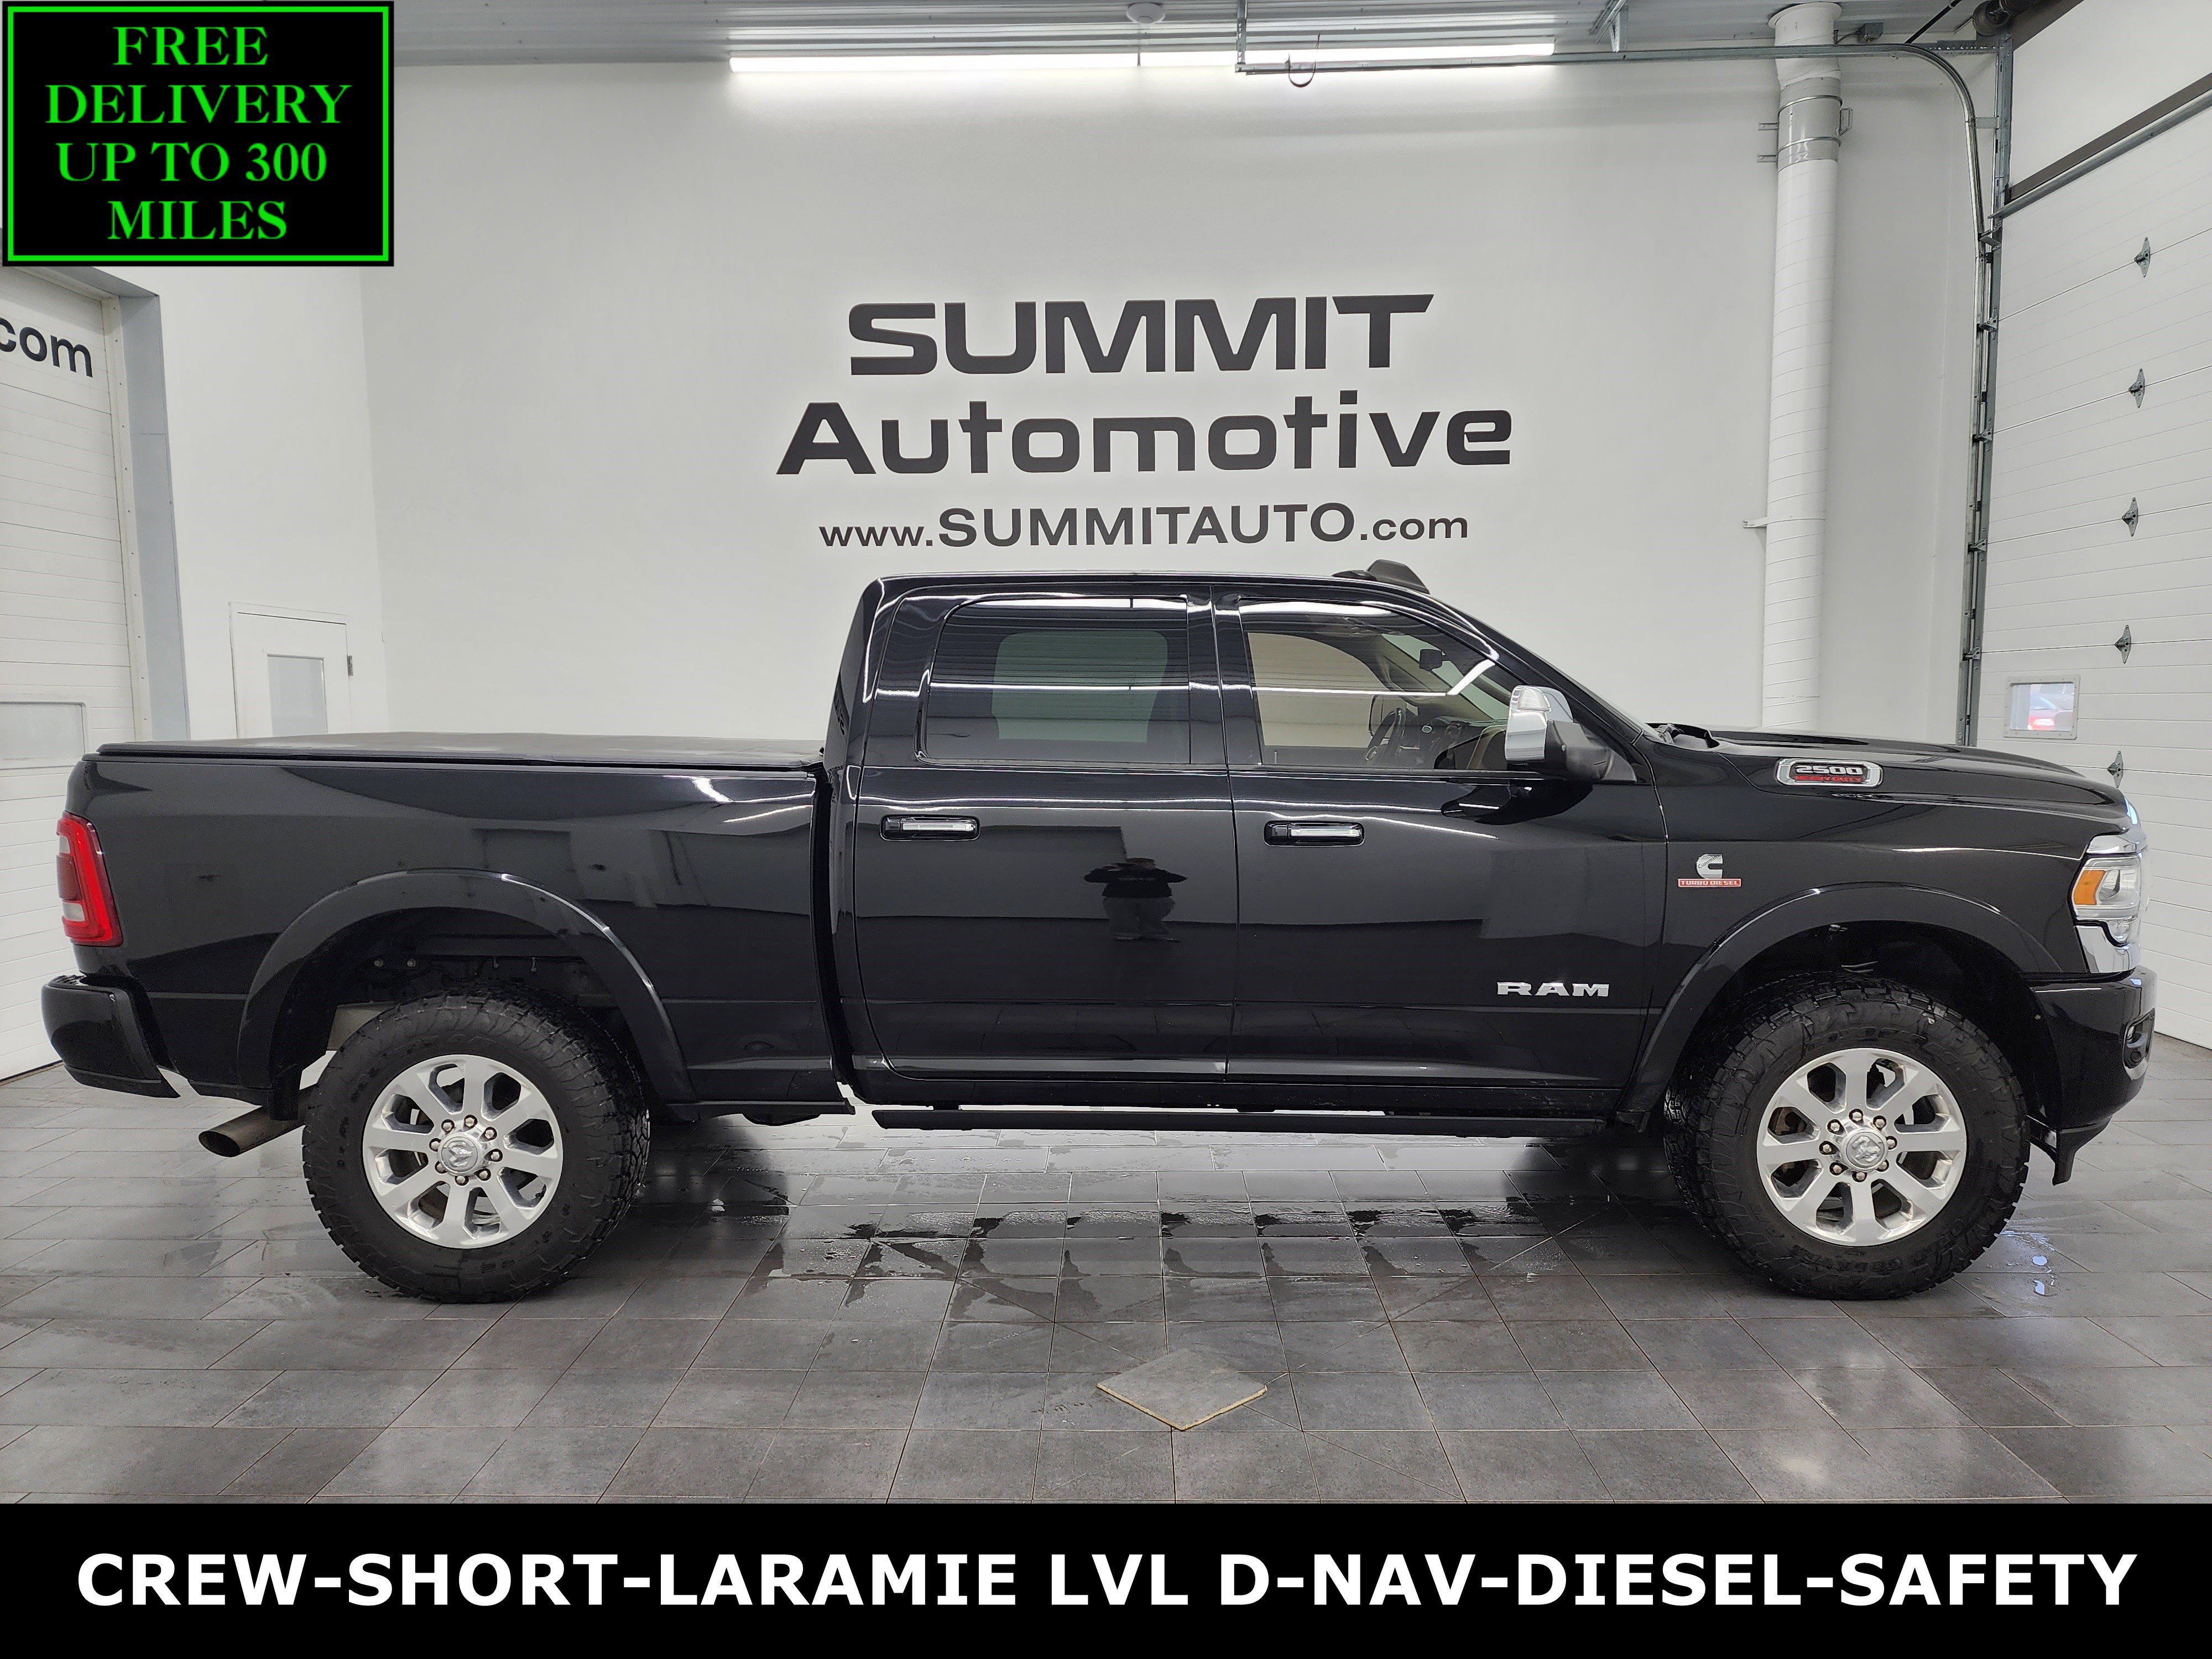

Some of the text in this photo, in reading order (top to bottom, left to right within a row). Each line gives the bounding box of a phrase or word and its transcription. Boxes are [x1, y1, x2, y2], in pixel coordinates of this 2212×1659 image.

[848, 294, 1434, 375] SUMMIT
[776, 389, 1512, 475] Automotive
[818, 502, 1468, 547] www.SUMMITAUTO.com
[1794, 765, 1863, 775] 2500
[1496, 982, 1610, 997] RAM
